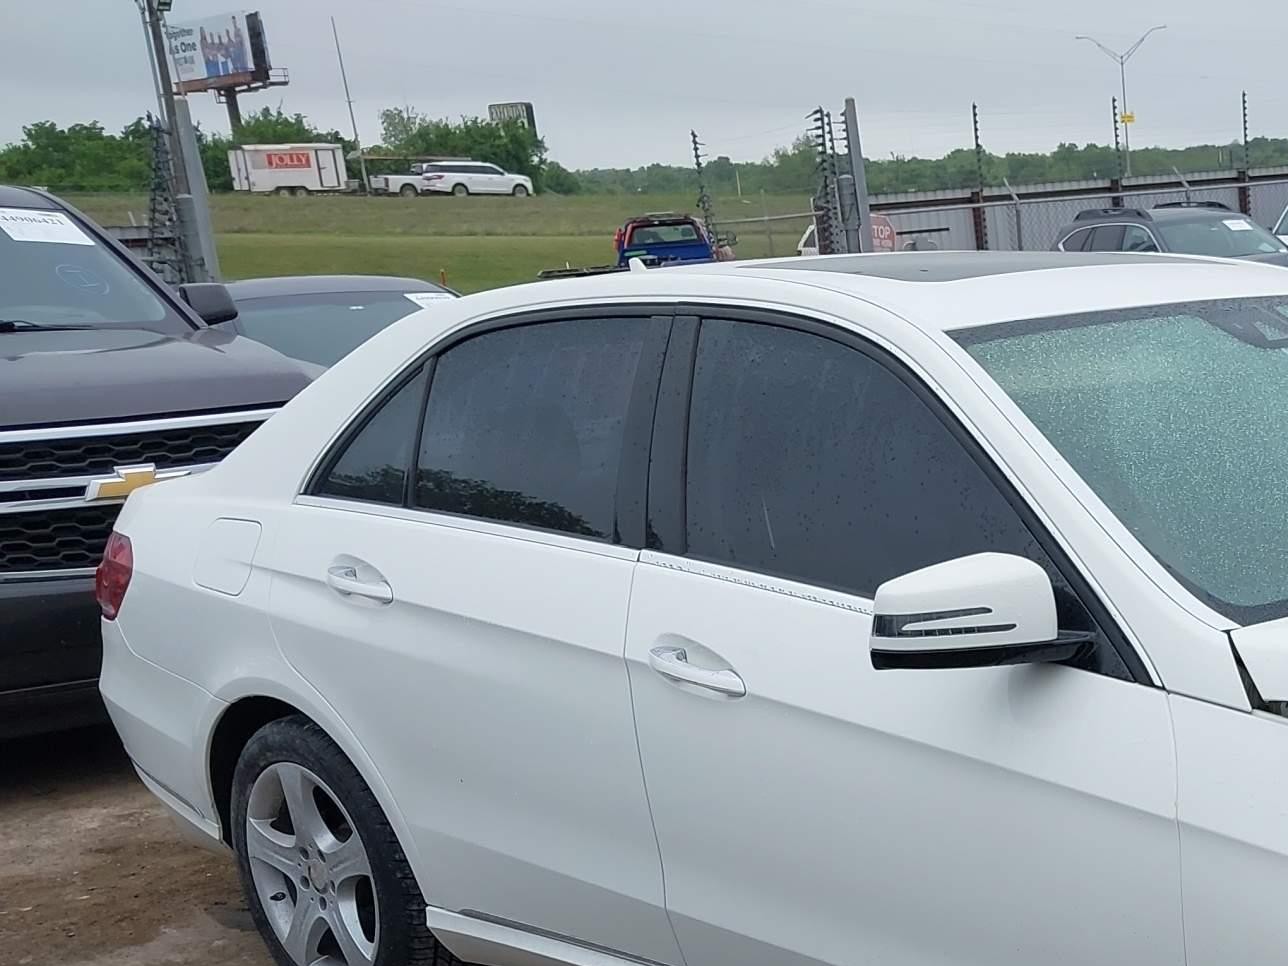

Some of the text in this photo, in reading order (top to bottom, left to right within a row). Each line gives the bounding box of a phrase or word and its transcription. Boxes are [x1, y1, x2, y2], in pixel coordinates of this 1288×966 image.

[180, 42, 197, 53] One
[269, 153, 308, 168] JOLLY
[872, 225, 891, 239] TOP
